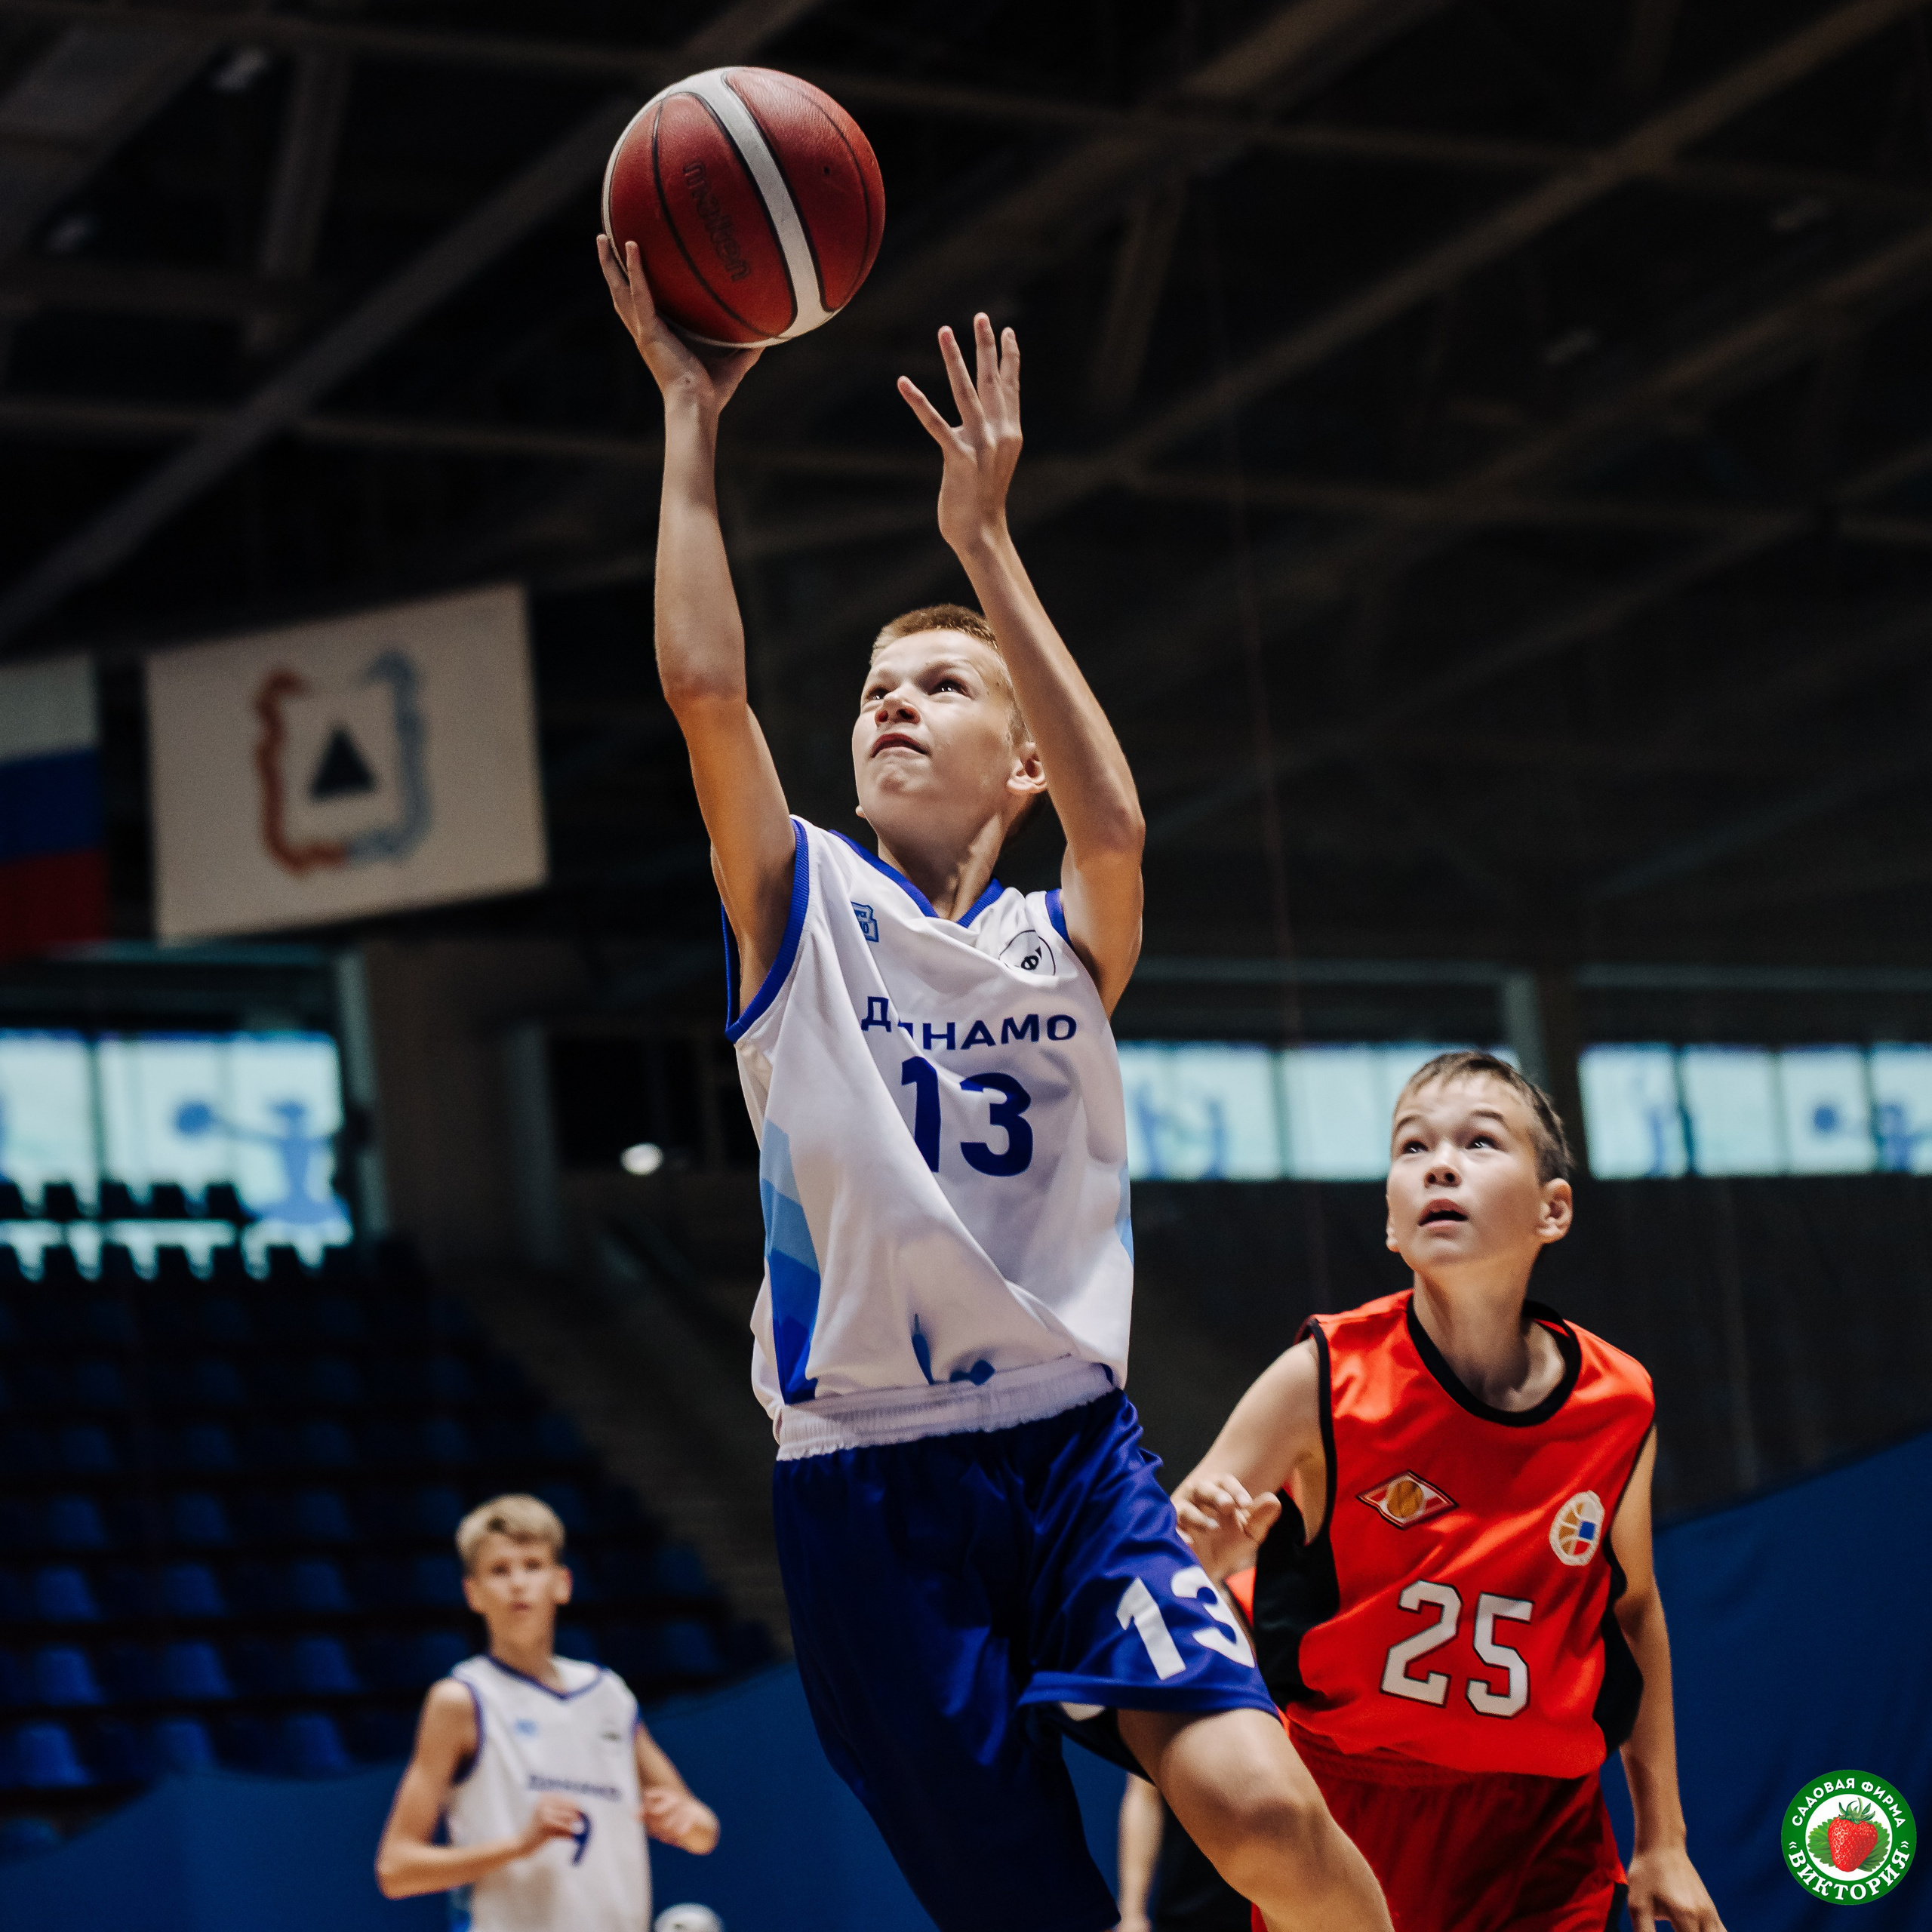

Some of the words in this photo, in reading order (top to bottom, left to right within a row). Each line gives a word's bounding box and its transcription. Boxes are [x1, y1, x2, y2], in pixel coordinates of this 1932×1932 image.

[901, 1056, 1033, 1177] 13
[1115, 1565, 1256, 1681] 13
[1380, 1580, 1534, 1719] 25
